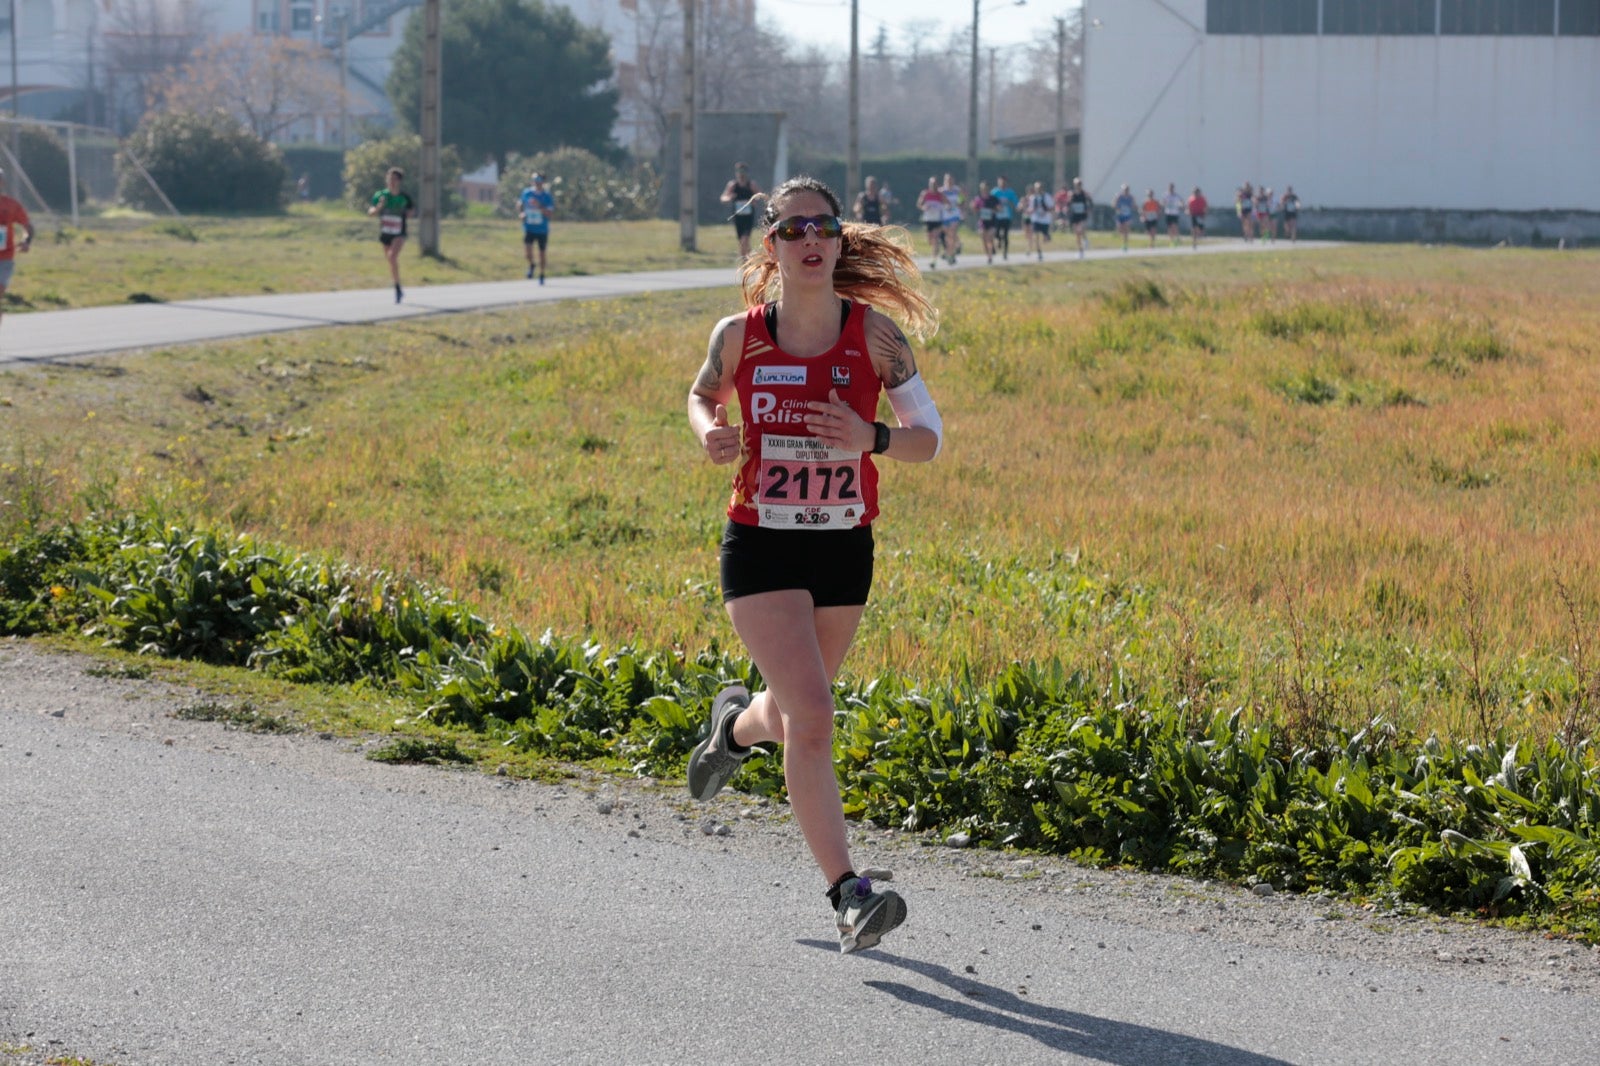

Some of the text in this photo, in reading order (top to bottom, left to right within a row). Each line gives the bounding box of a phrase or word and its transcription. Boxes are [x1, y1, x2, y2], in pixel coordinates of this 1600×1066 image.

[751, 392, 803, 424] Polis
[782, 399, 808, 409] Clíni
[787, 440, 804, 449] GRAN
[764, 465, 857, 499] 2172
